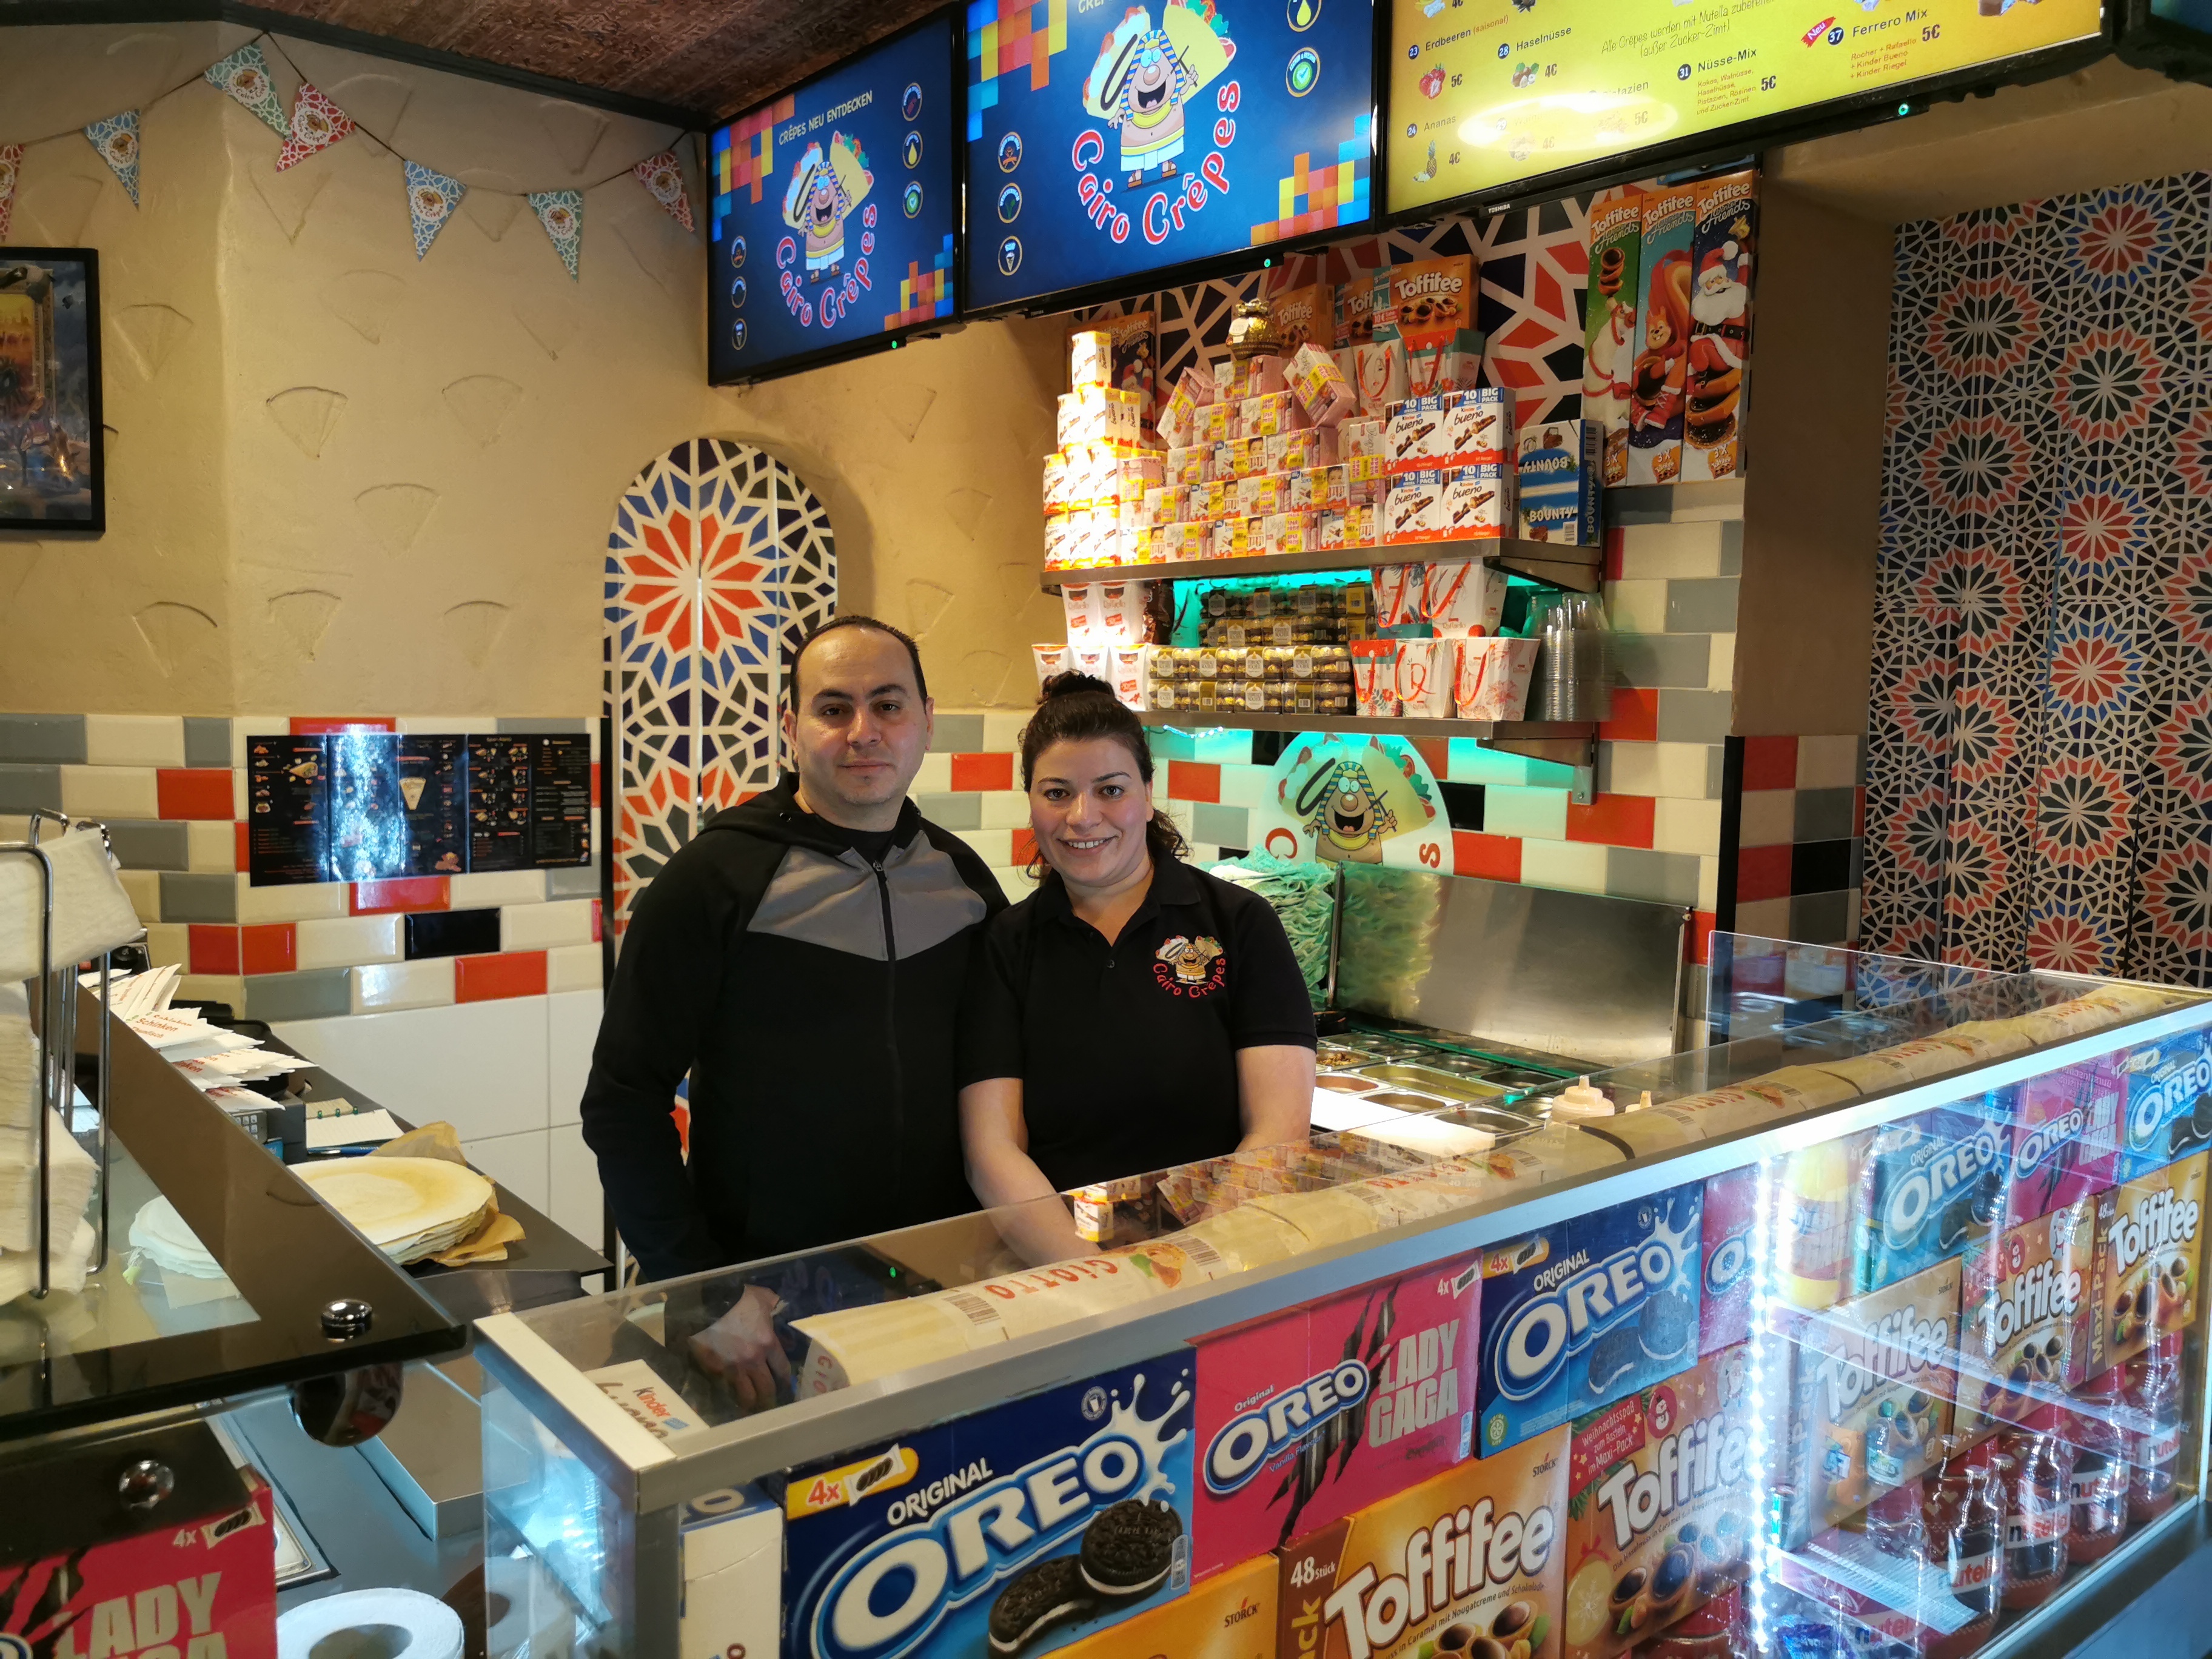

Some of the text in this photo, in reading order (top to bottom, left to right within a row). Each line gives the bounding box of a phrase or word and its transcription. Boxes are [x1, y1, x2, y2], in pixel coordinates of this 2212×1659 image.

[1425, 15, 1509, 52] Erdbeeren (saisonal)
[1601, 40, 1617, 55] Alle
[1619, 32, 1648, 50] Crêpes
[1651, 21, 1681, 39] werden
[1683, 15, 1697, 30] mit
[1700, 5, 1729, 24] Nutella
[1670, 18, 1731, 49] Zucker-Zimt)
[1806, 21, 1826, 41] Neu
[1829, 30, 1842, 42] 37
[1852, 8, 1928, 38] Ferrero Mix
[1922, 24, 1941, 42] 5€
[1409, 47, 1418, 56] 23
[1498, 45, 1509, 56] 28
[1516, 26, 1572, 52] Haselnüsse
[1698, 49, 1757, 73] Nüsse-Mix
[1851, 48, 1878, 61] Rocher
[1857, 56, 1882, 69] Kinder
[1883, 50, 1908, 62] Bueno
[1451, 73, 1463, 88] 5€
[1544, 63, 1558, 78] 4€
[1679, 66, 1689, 78] 31
[1857, 67, 1882, 78] Kinder
[1883, 59, 1907, 73] Riegel
[1603, 81, 1649, 96] tazien
[1730, 85, 1757, 98] Rosinen
[1761, 75, 1777, 92] 5€
[779, 90, 873, 146] CRÊPES NEU ENTDECKEN
[1697, 96, 1750, 116] und Zucker-Zimt
[1407, 126, 1417, 136] 24
[1423, 115, 1457, 132] Ananas
[1449, 151, 1461, 166] 4€
[1071, 129, 1130, 244] Cairo
[1698, 182, 1751, 213] Toffifee
[1487, 203, 1512, 214] TOSHIBA
[1592, 205, 1640, 235] Toffifee
[1643, 194, 1695, 226] Toffifee
[776, 236, 813, 327] Cairo
[1395, 272, 1463, 300] Toffifee
[1404, 394, 1438, 409] 10 BIG
[1464, 387, 1499, 401] 10 BIG
[1481, 395, 1499, 403] PACK
[1395, 418, 1424, 434] bueno
[1454, 409, 1484, 426] bueno
[1403, 469, 1436, 482] 10 BIG
[1463, 463, 1498, 476] 10 BIG
[1523, 456, 1568, 473] BOUNTY
[1395, 491, 1422, 506] bueno
[1452, 485, 1483, 500] bueno
[1586, 475, 1596, 534] BOUNTY
[1529, 507, 1573, 523] BOUNTY
[1153, 963, 1182, 996] Cairo
[135, 1017, 179, 1033] Schinken
[2134, 1062, 2211, 1142] OREO
[1910, 1136, 1945, 1167] ORIGINAL
[2019, 1110, 2082, 1170] OREO
[1891, 1132, 1995, 1232] OREO
[2108, 1188, 2200, 1275] Toffifee
[1489, 1254, 1509, 1273] 4x
[1533, 1248, 1590, 1292] ORIGINAL
[1438, 1278, 1450, 1296] 4x
[2092, 1227, 2109, 1364] Maxi-Pack
[1506, 1245, 1672, 1381] OREO
[1977, 1258, 2082, 1361] Toffifee
[1379, 1318, 1460, 1395] LADY
[1815, 1305, 1949, 1423] Toffifee
[1234, 1384, 1275, 1413] Original
[1368, 1367, 1458, 1449] GAGA
[1213, 1366, 1364, 1480] OREO
[1581, 1399, 1635, 1447] Weihnachtsspaß
[1594, 1424, 1626, 1454] zum Basteln
[1269, 1451, 1295, 1473] Vanilla
[1588, 1432, 1634, 1475] im Maxi-Pack
[1532, 1458, 1557, 1478] STORCK
[807, 1478, 841, 1506] 4x
[886, 1457, 994, 1526] ORIGINAL
[172, 1529, 198, 1547] 4x
[832, 1440, 1139, 1652] OREO
[1290, 1557, 1336, 1588] 48 Stück
[1324, 1496, 1555, 1659] Toffifee
[53, 1570, 223, 1659] LADY
[1224, 1602, 1259, 1629] STORCK
[1407, 1620, 1438, 1647] Caramel
[1438, 1611, 1451, 1627] mit
[1451, 1593, 1497, 1620] Nougatcreme
[1497, 1585, 1510, 1600] und
[1510, 1580, 1545, 1595] Schokolade
